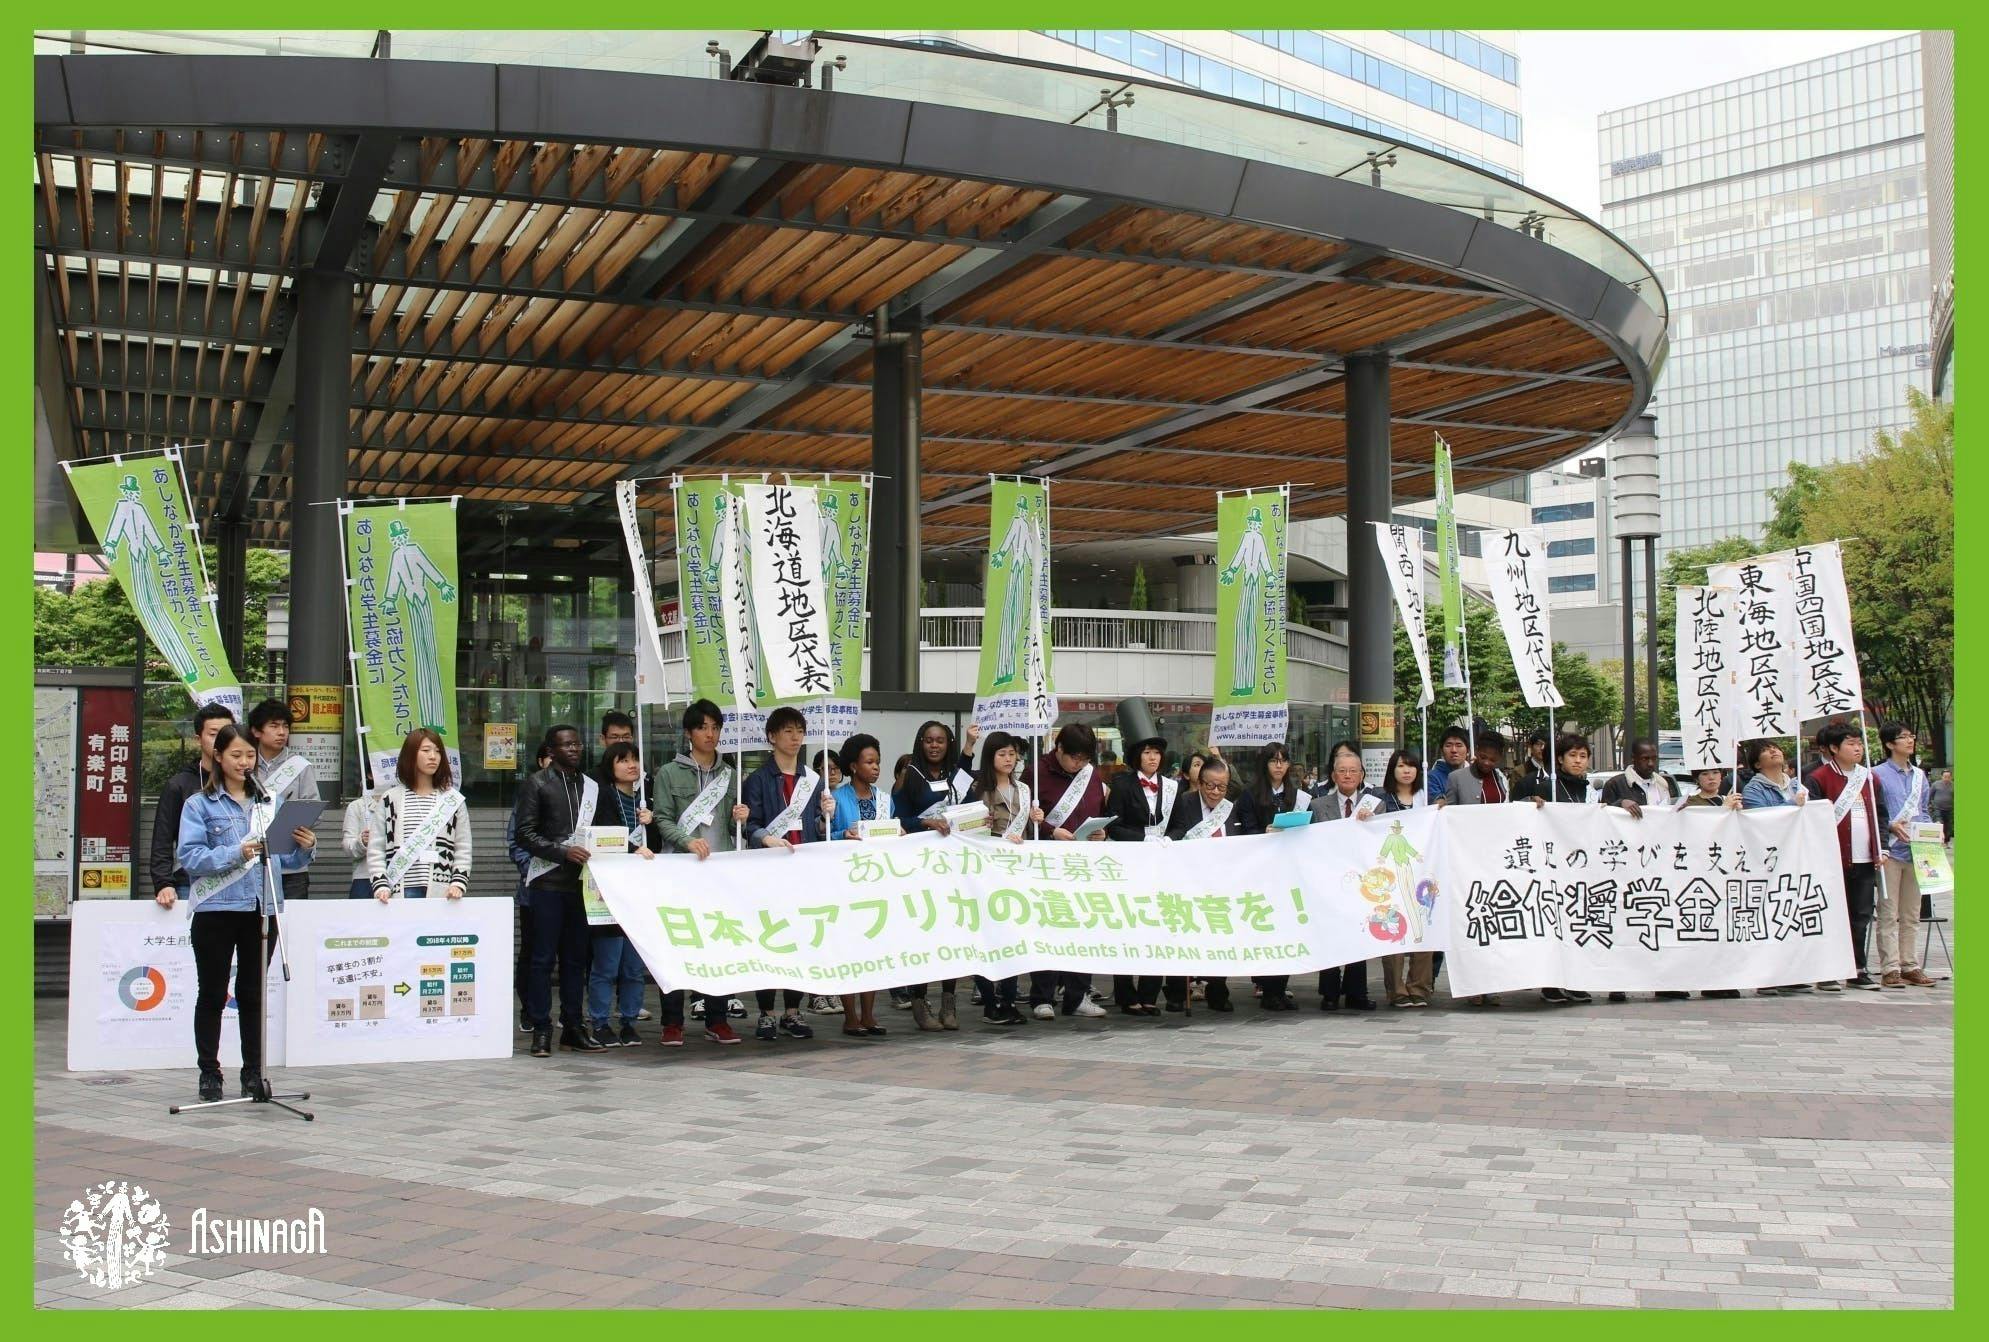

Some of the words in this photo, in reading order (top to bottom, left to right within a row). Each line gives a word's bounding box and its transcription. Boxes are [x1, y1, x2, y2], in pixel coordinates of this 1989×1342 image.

[764, 486, 831, 694] 北海道地区代表
[1503, 529, 1556, 704] 九州地区代表
[1692, 588, 1724, 766] 北陸地区代表
[1738, 564, 1786, 735] 東海地区代表
[86, 734, 106, 793] 有楽町
[108, 724, 130, 803] 無印良品
[843, 846, 1129, 883] あしなが学生募金
[1503, 836, 1779, 875] 遺児の学びを支える
[1464, 874, 1829, 951] 給付奨学金開始
[684, 959, 804, 980] Educational
[809, 954, 894, 981] Support
[899, 949, 931, 968] for
[1034, 940, 1118, 959] Students
[1123, 943, 1140, 959] in
[1146, 944, 1201, 961] JAPAN
[1207, 943, 1237, 962] and
[1242, 942, 1311, 962] AFRICA
